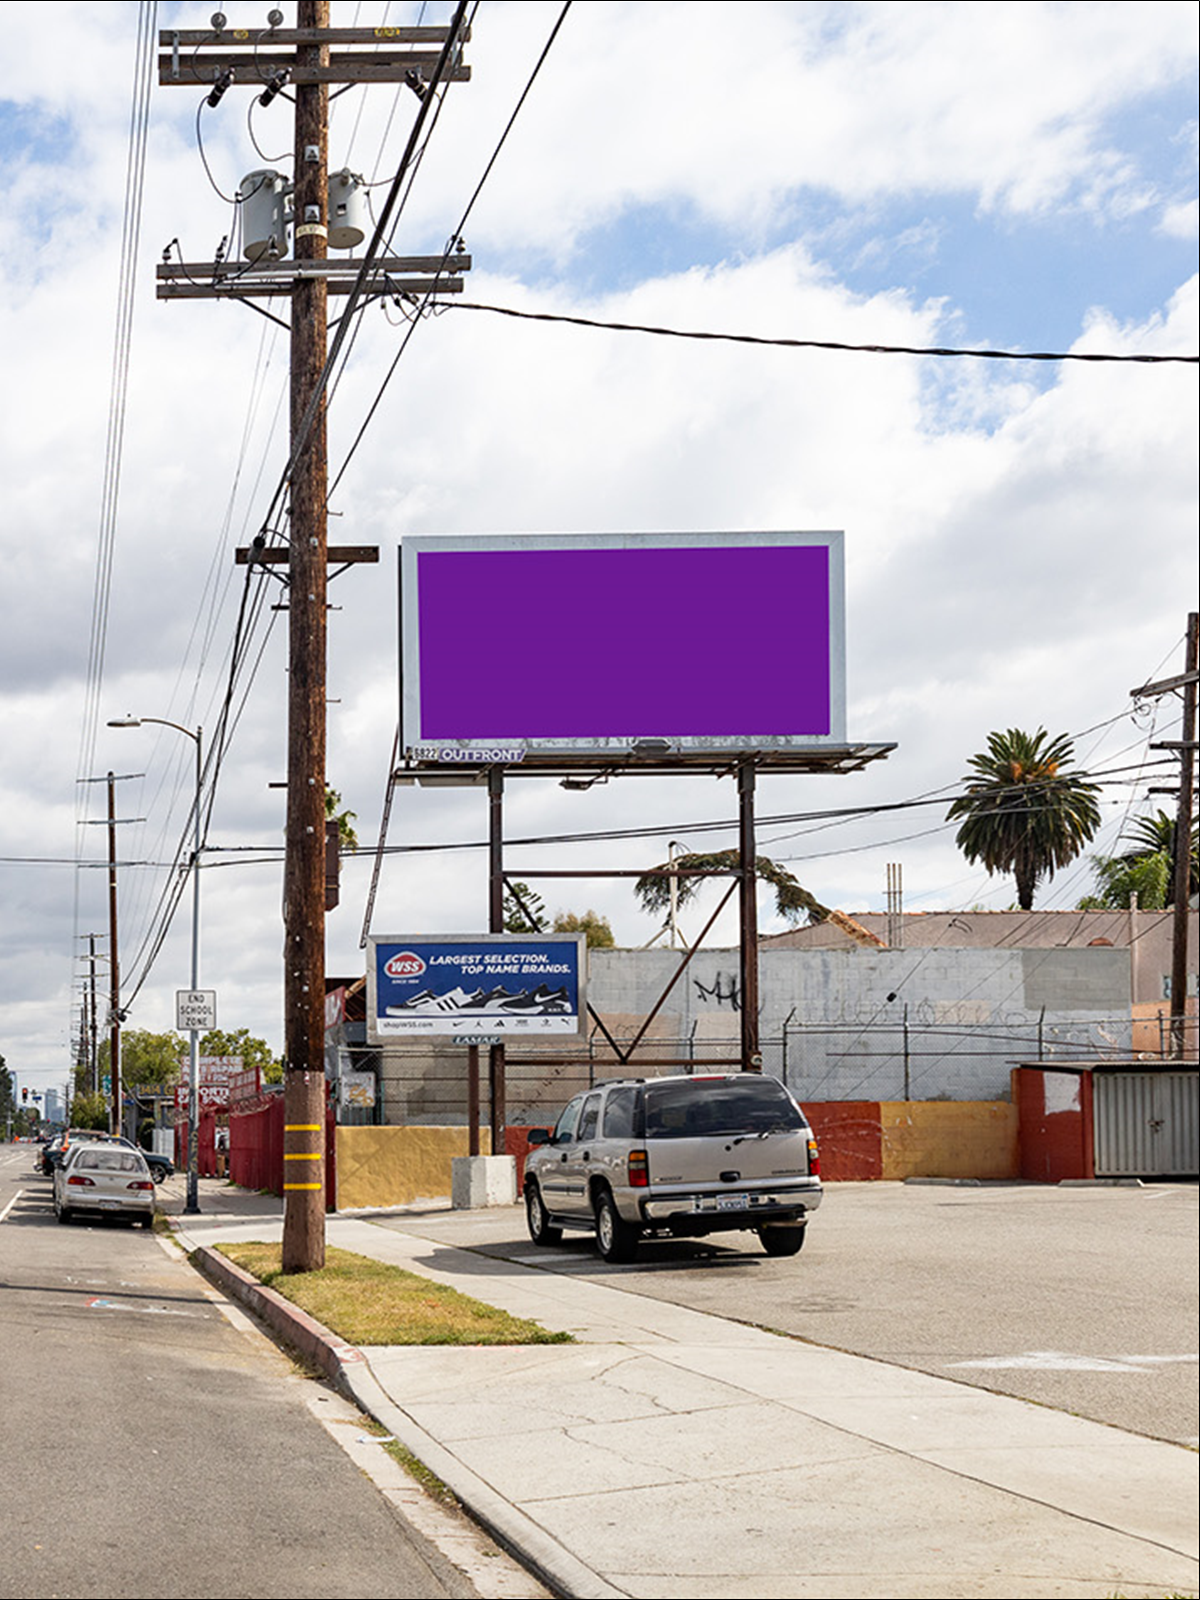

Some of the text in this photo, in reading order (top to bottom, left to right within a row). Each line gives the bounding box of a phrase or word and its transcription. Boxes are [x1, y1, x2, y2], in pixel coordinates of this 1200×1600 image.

[442, 748, 521, 760] OUTFRONT
[429, 954, 549, 965] LARGEST SELECTION.
[390, 960, 421, 973] WSS
[461, 964, 571, 974] TOP NAME BRANDS.
[188, 994, 205, 1003] END
[180, 1005, 212, 1015] SCHOOL
[186, 1017, 207, 1026] ZONE
[383, 1021, 433, 1029] shopWSS.com
[455, 1036, 500, 1044] LAMAR
